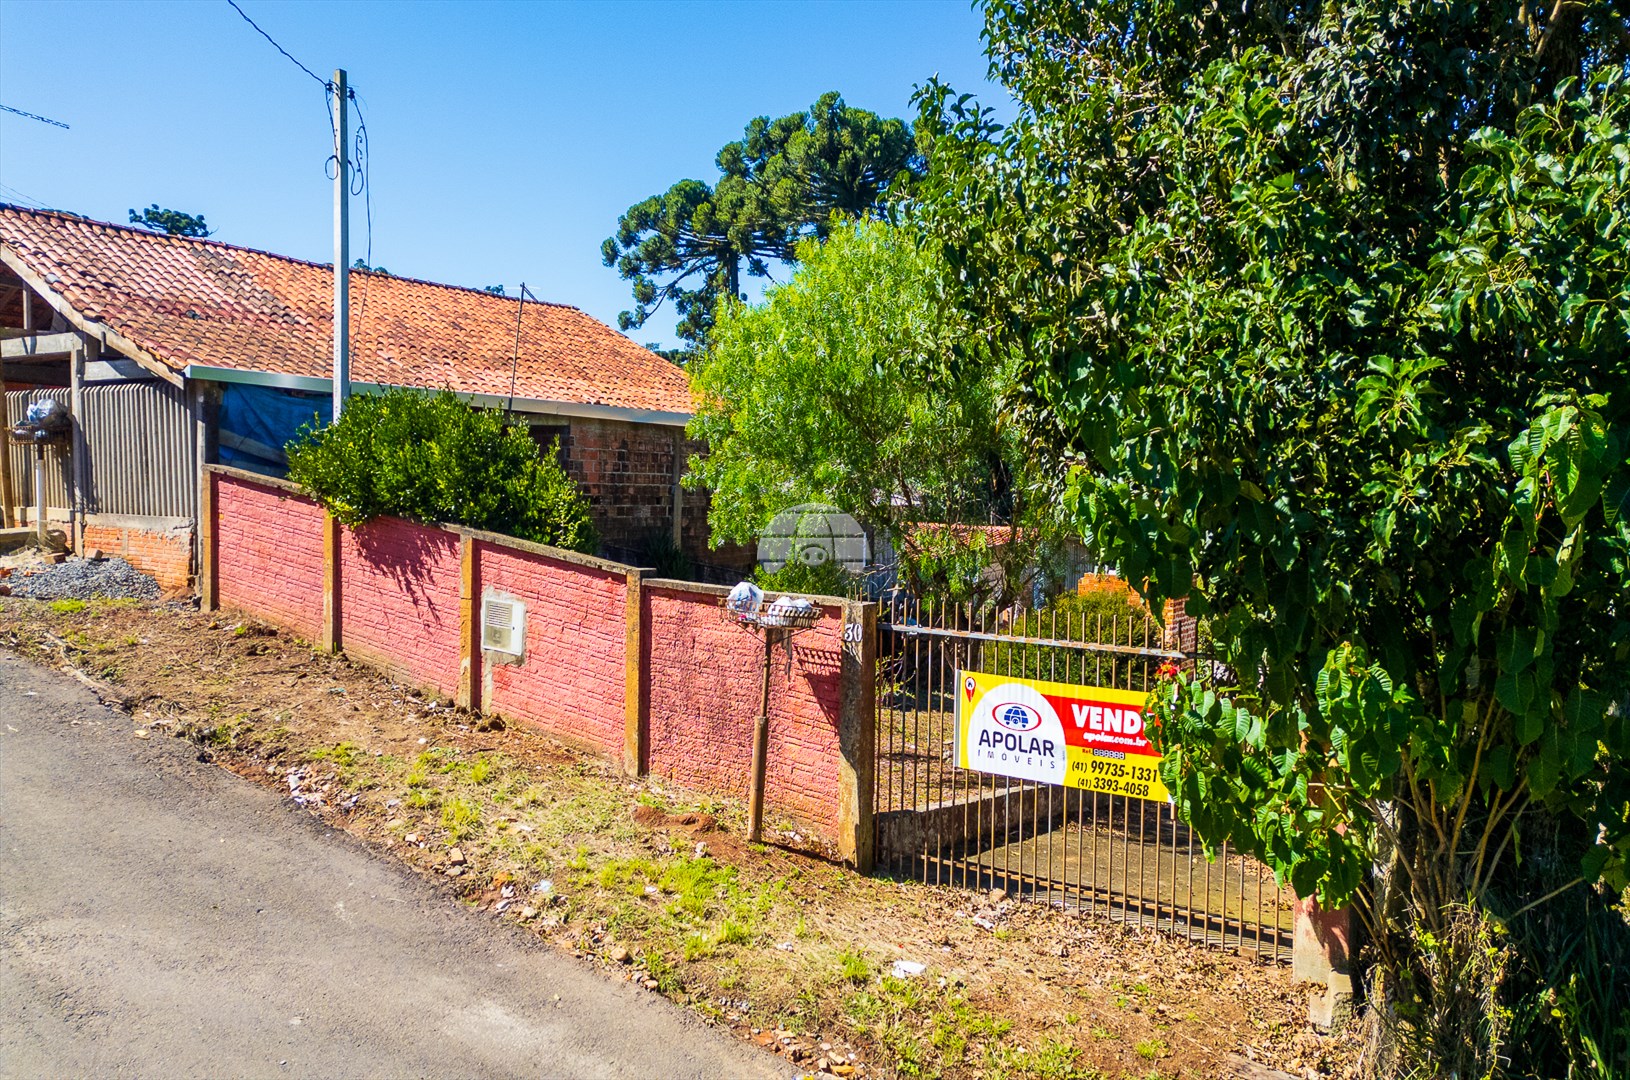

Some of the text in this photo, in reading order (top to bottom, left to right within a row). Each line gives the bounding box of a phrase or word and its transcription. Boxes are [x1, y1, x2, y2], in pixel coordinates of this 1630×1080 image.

[844, 623, 862, 642] 30
[1071, 703, 1155, 735] VEND
[978, 729, 1055, 758] APOLAR
[1083, 731, 1148, 747] apolar.com.br
[1071, 760, 1158, 783] (41) 99735-1331
[1077, 776, 1150, 797] (41) 3393-4058
